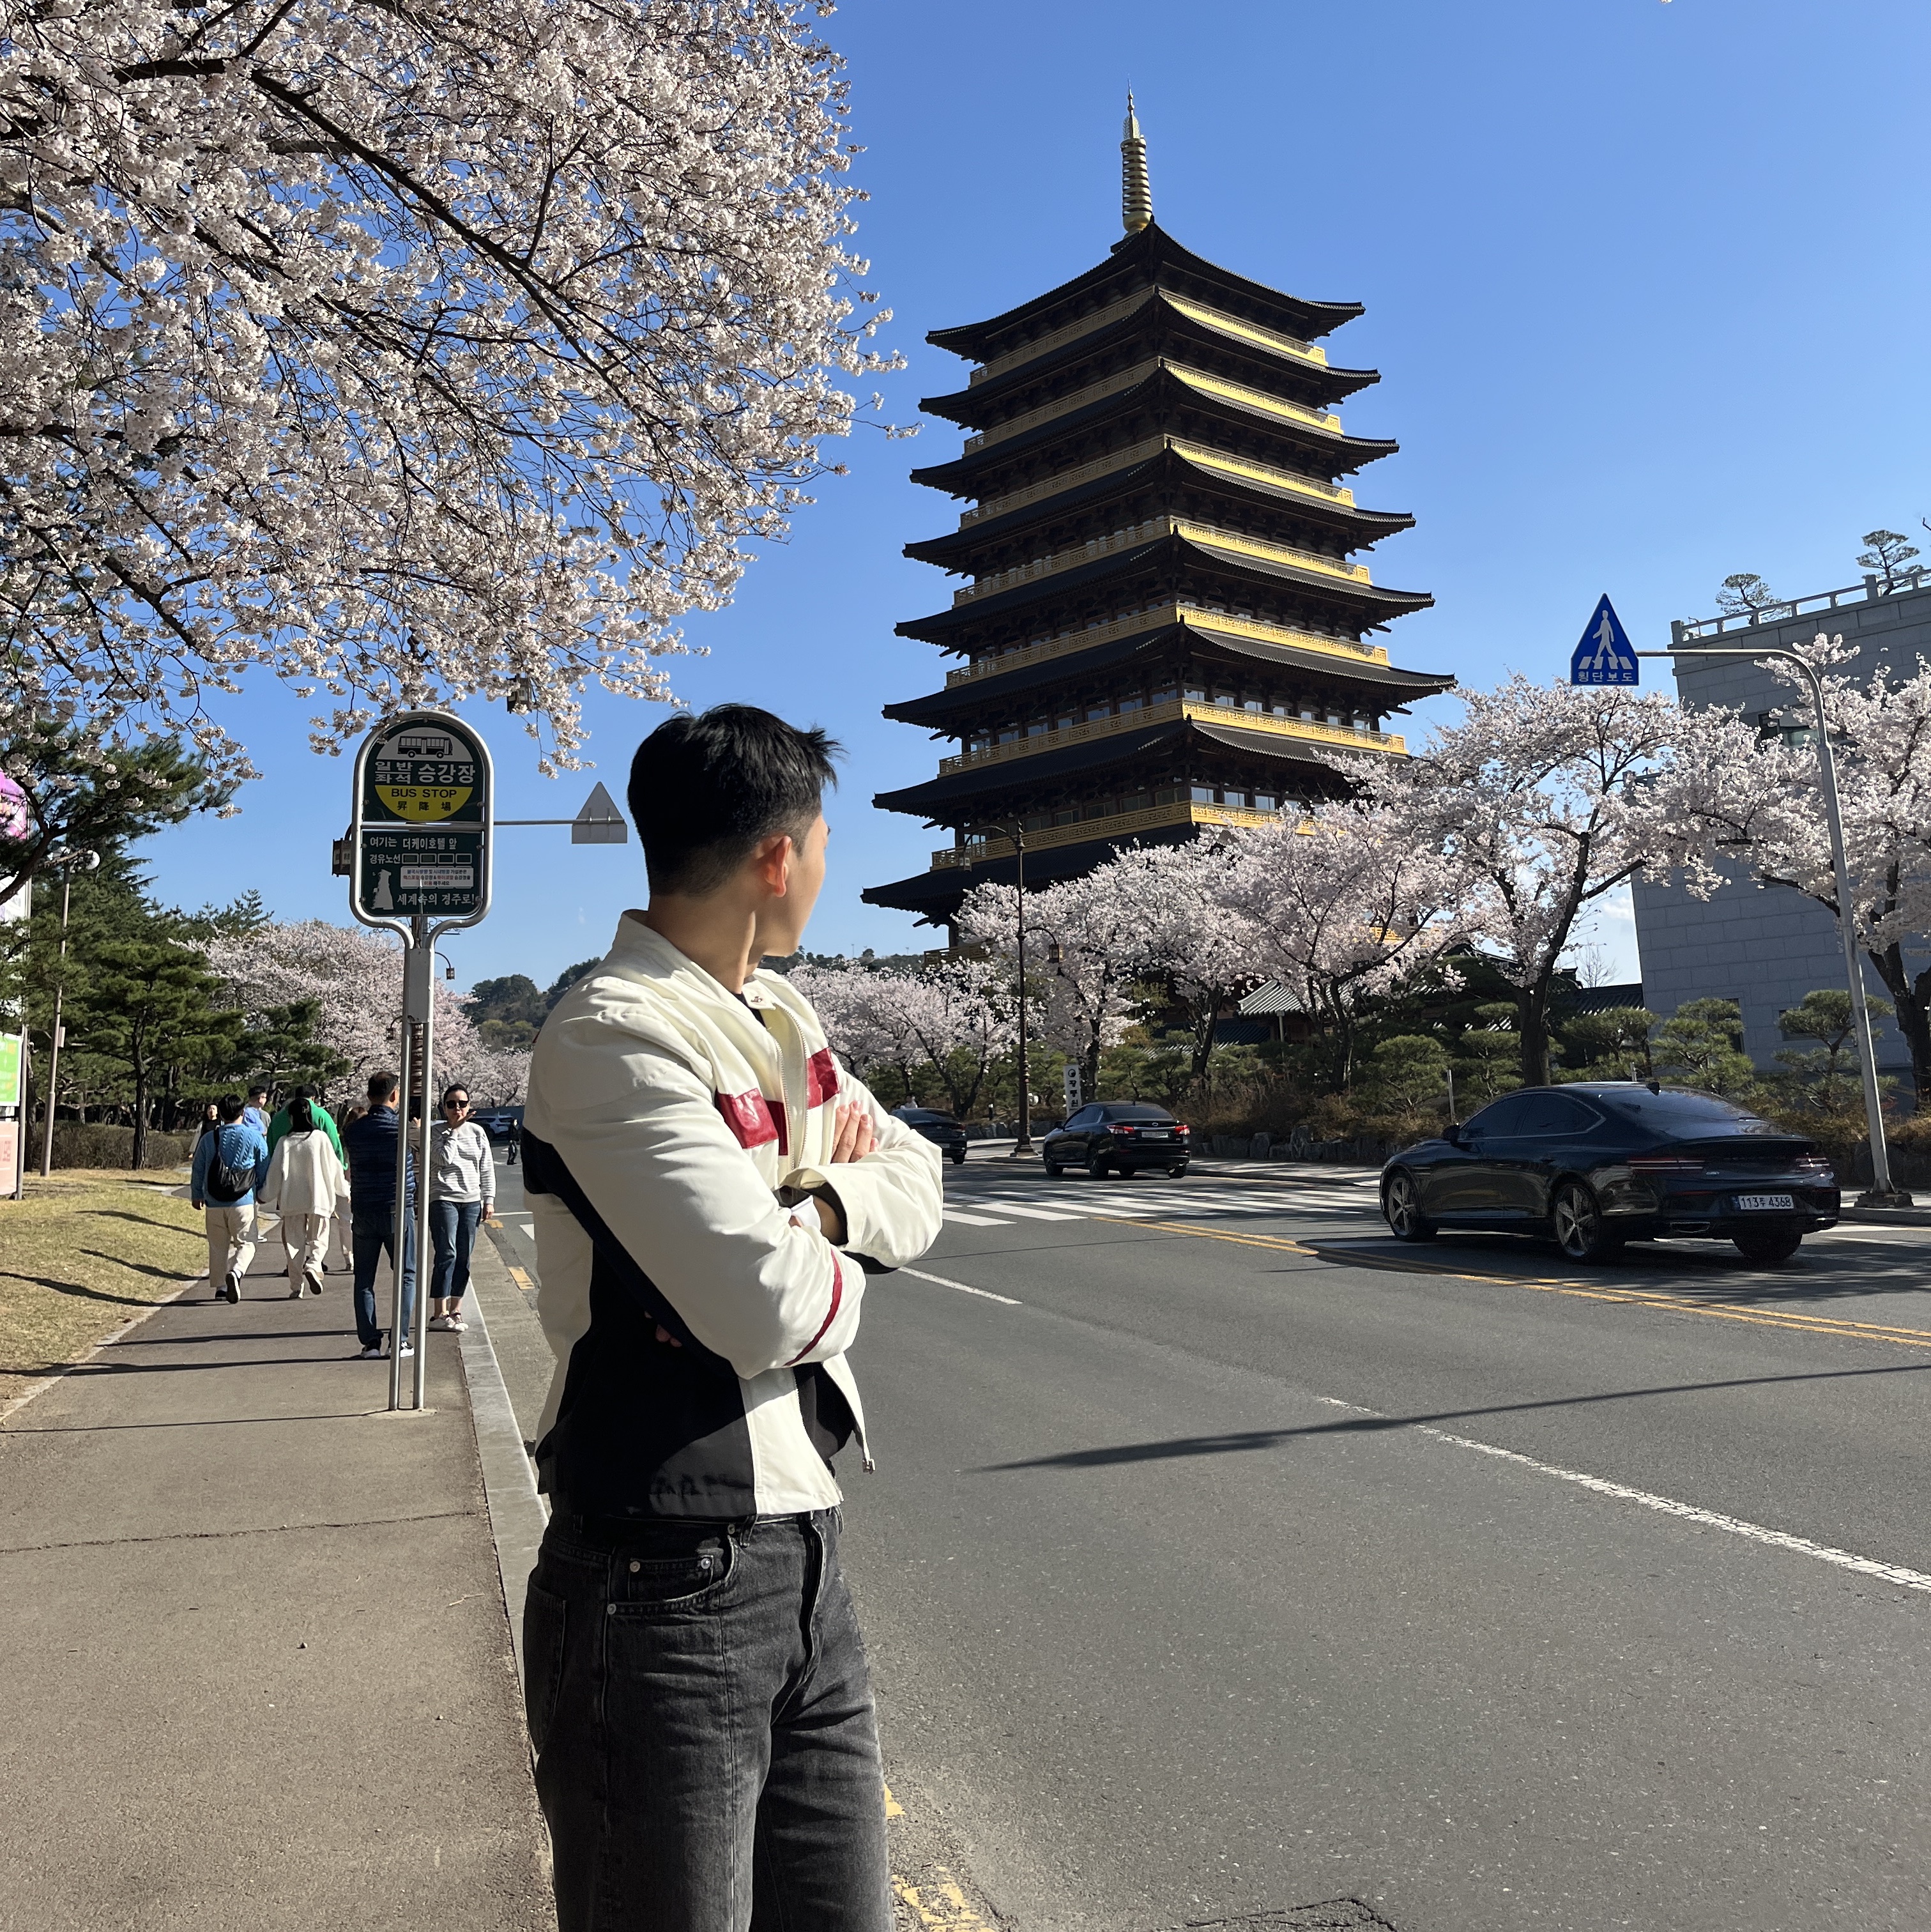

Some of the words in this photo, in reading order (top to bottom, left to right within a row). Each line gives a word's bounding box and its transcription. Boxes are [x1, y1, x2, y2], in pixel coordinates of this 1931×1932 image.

[1578, 671, 1633, 682] 횡단보도
[375, 761, 413, 771] 일반
[418, 763, 475, 784] 승강장
[375, 774, 411, 785] 좌석
[391, 788, 416, 797] BUS
[422, 789, 457, 798] STOP
[370, 836, 397, 848] 여기는
[402, 838, 445, 850] 더케이호텔
[448, 838, 457, 850] 앞
[370, 854, 401, 864] 경유노선
[397, 893, 437, 905] 세계속의
[441, 893, 475, 905] 경주로!
